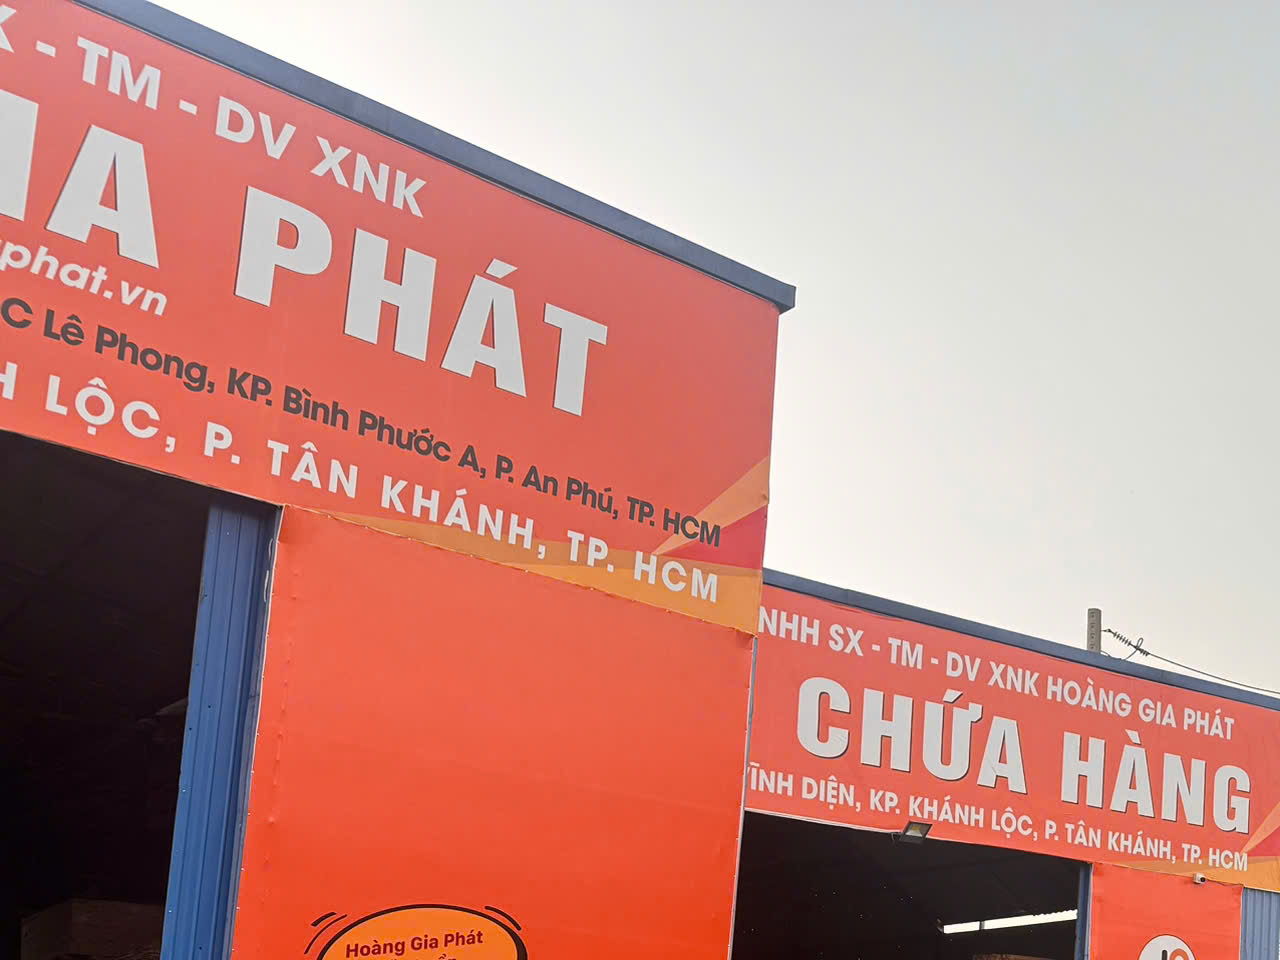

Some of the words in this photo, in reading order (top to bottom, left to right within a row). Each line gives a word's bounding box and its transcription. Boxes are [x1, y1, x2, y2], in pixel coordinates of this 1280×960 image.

[76, 36, 161, 110] TM
[215, 95, 297, 160] DV
[310, 135, 427, 218] XNK
[0, 240, 167, 316] phat.vn
[234, 185, 608, 418] PHÁT
[43, 308, 84, 346] Lê
[94, 324, 216, 393] Phong,
[227, 367, 272, 406] KP.
[283, 385, 348, 430] Bình
[358, 409, 450, 462] Phước
[458, 444, 486, 478] A,
[495, 454, 514, 483] P.
[522, 465, 558, 496] An
[566, 476, 618, 520] Phú,
[626, 495, 655, 527] TP.
[662, 508, 721, 547] HCM
[44, 374, 177, 453] LỘC,
[203, 421, 241, 465] P.
[266, 439, 358, 499] TÂN
[380, 474, 546, 560] KHÁNH,
[567, 530, 615, 573] TP.
[633, 550, 718, 603] HCM
[758, 605, 820, 646] NHH
[828, 624, 864, 657] SX
[888, 637, 923, 670] TM
[946, 650, 981, 682] DV
[988, 661, 1040, 697] XNK
[1046, 676, 1132, 718] HOÀNG
[1138, 698, 1176, 729] GIA
[1183, 707, 1235, 741] PHÁT
[747, 761, 793, 797] ĨNH
[801, 775, 862, 812] DIỆN,
[869, 788, 901, 814] KP.
[908, 795, 984, 829] KHÁNH
[991, 806, 1038, 841] LỘC,
[1044, 819, 1059, 840] P.
[1064, 820, 1103, 849] TÂN
[1107, 830, 1176, 864] KHÁNH,
[1182, 842, 1203, 865] TP.
[1208, 848, 1248, 872] HCM
[796, 676, 1028, 795] CHỨA
[1060, 729, 1252, 835] HÀNG
[345, 939, 405, 959] Hoàng
[411, 934, 439, 951] Gia
[444, 929, 484, 947] Phát
